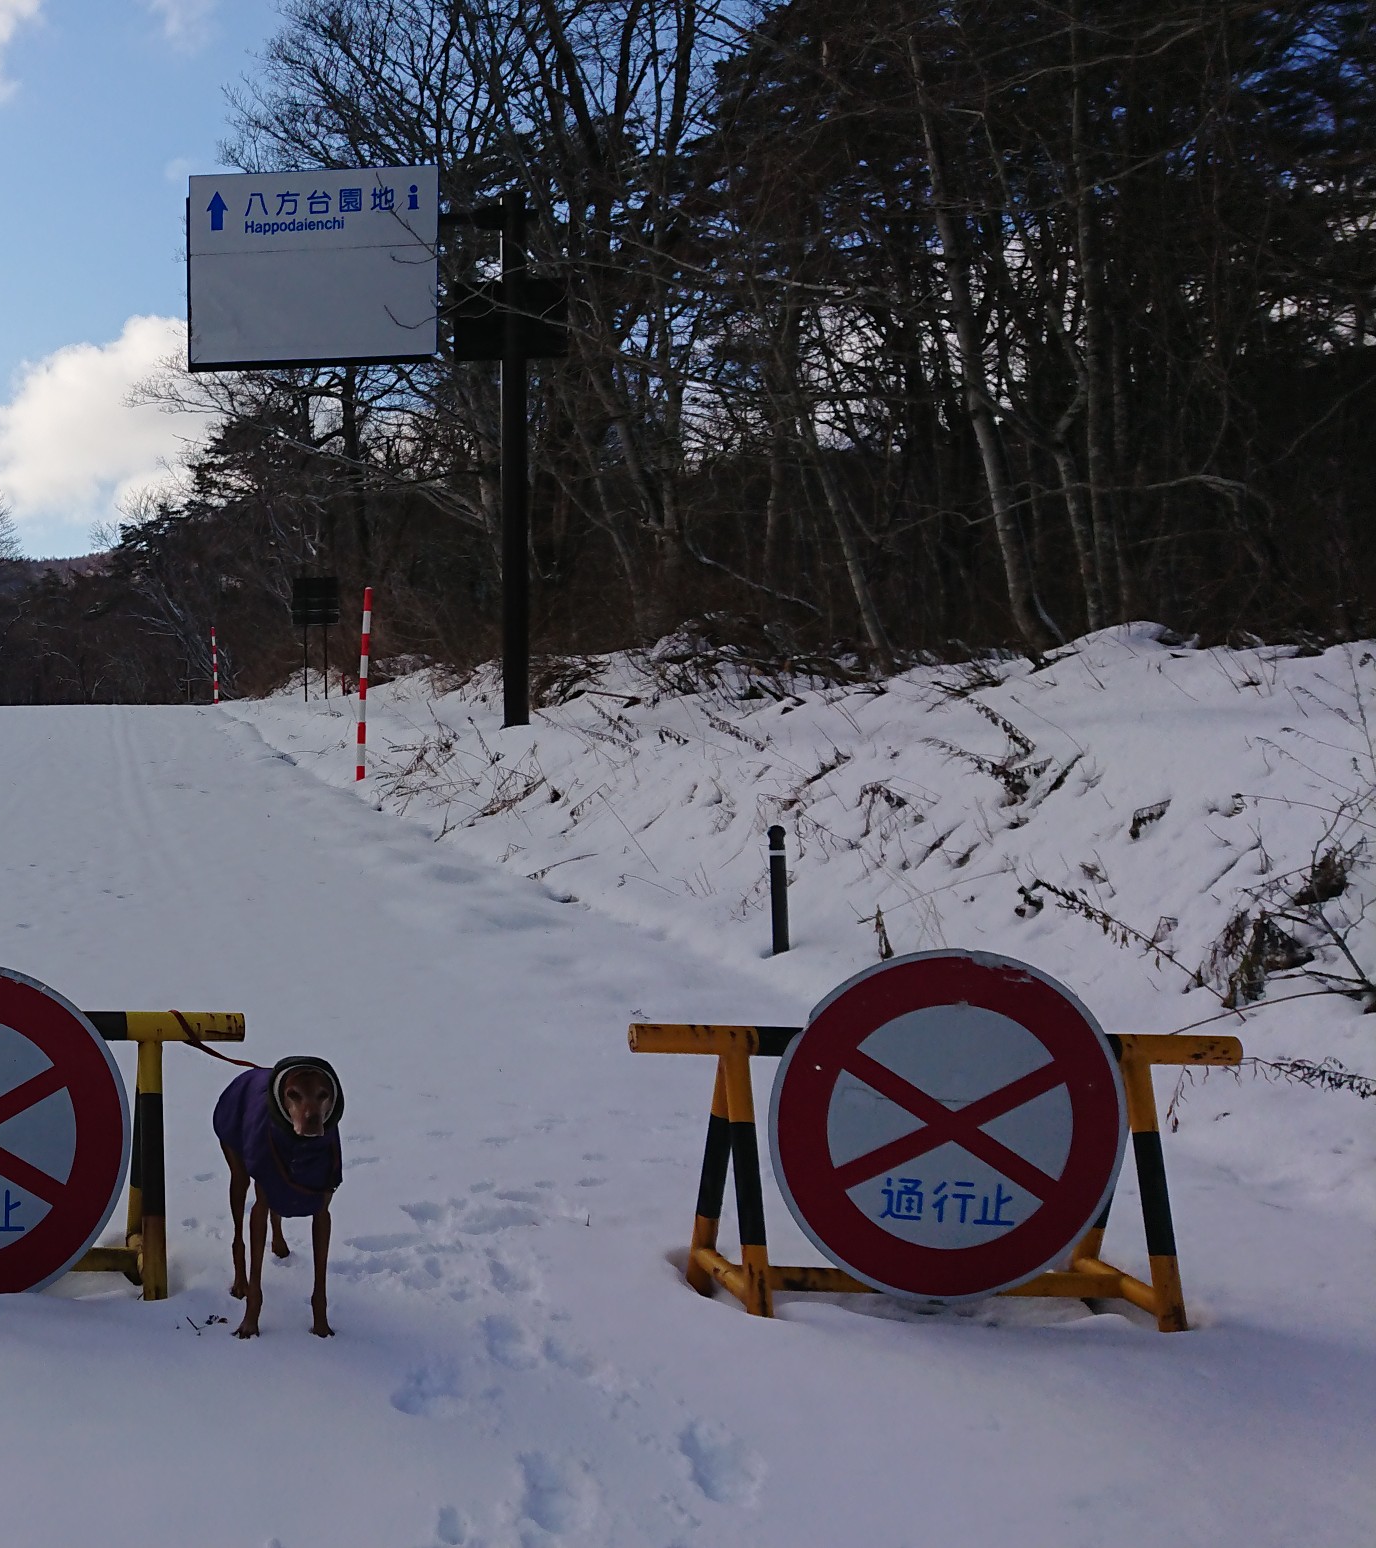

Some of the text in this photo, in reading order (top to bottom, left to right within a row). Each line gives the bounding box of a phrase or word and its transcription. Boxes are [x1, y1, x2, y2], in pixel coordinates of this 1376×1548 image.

[244, 185, 395, 217] 八方台園地
[244, 217, 345, 236] Happodaienchi
[878, 1177, 1016, 1227] 通行止
